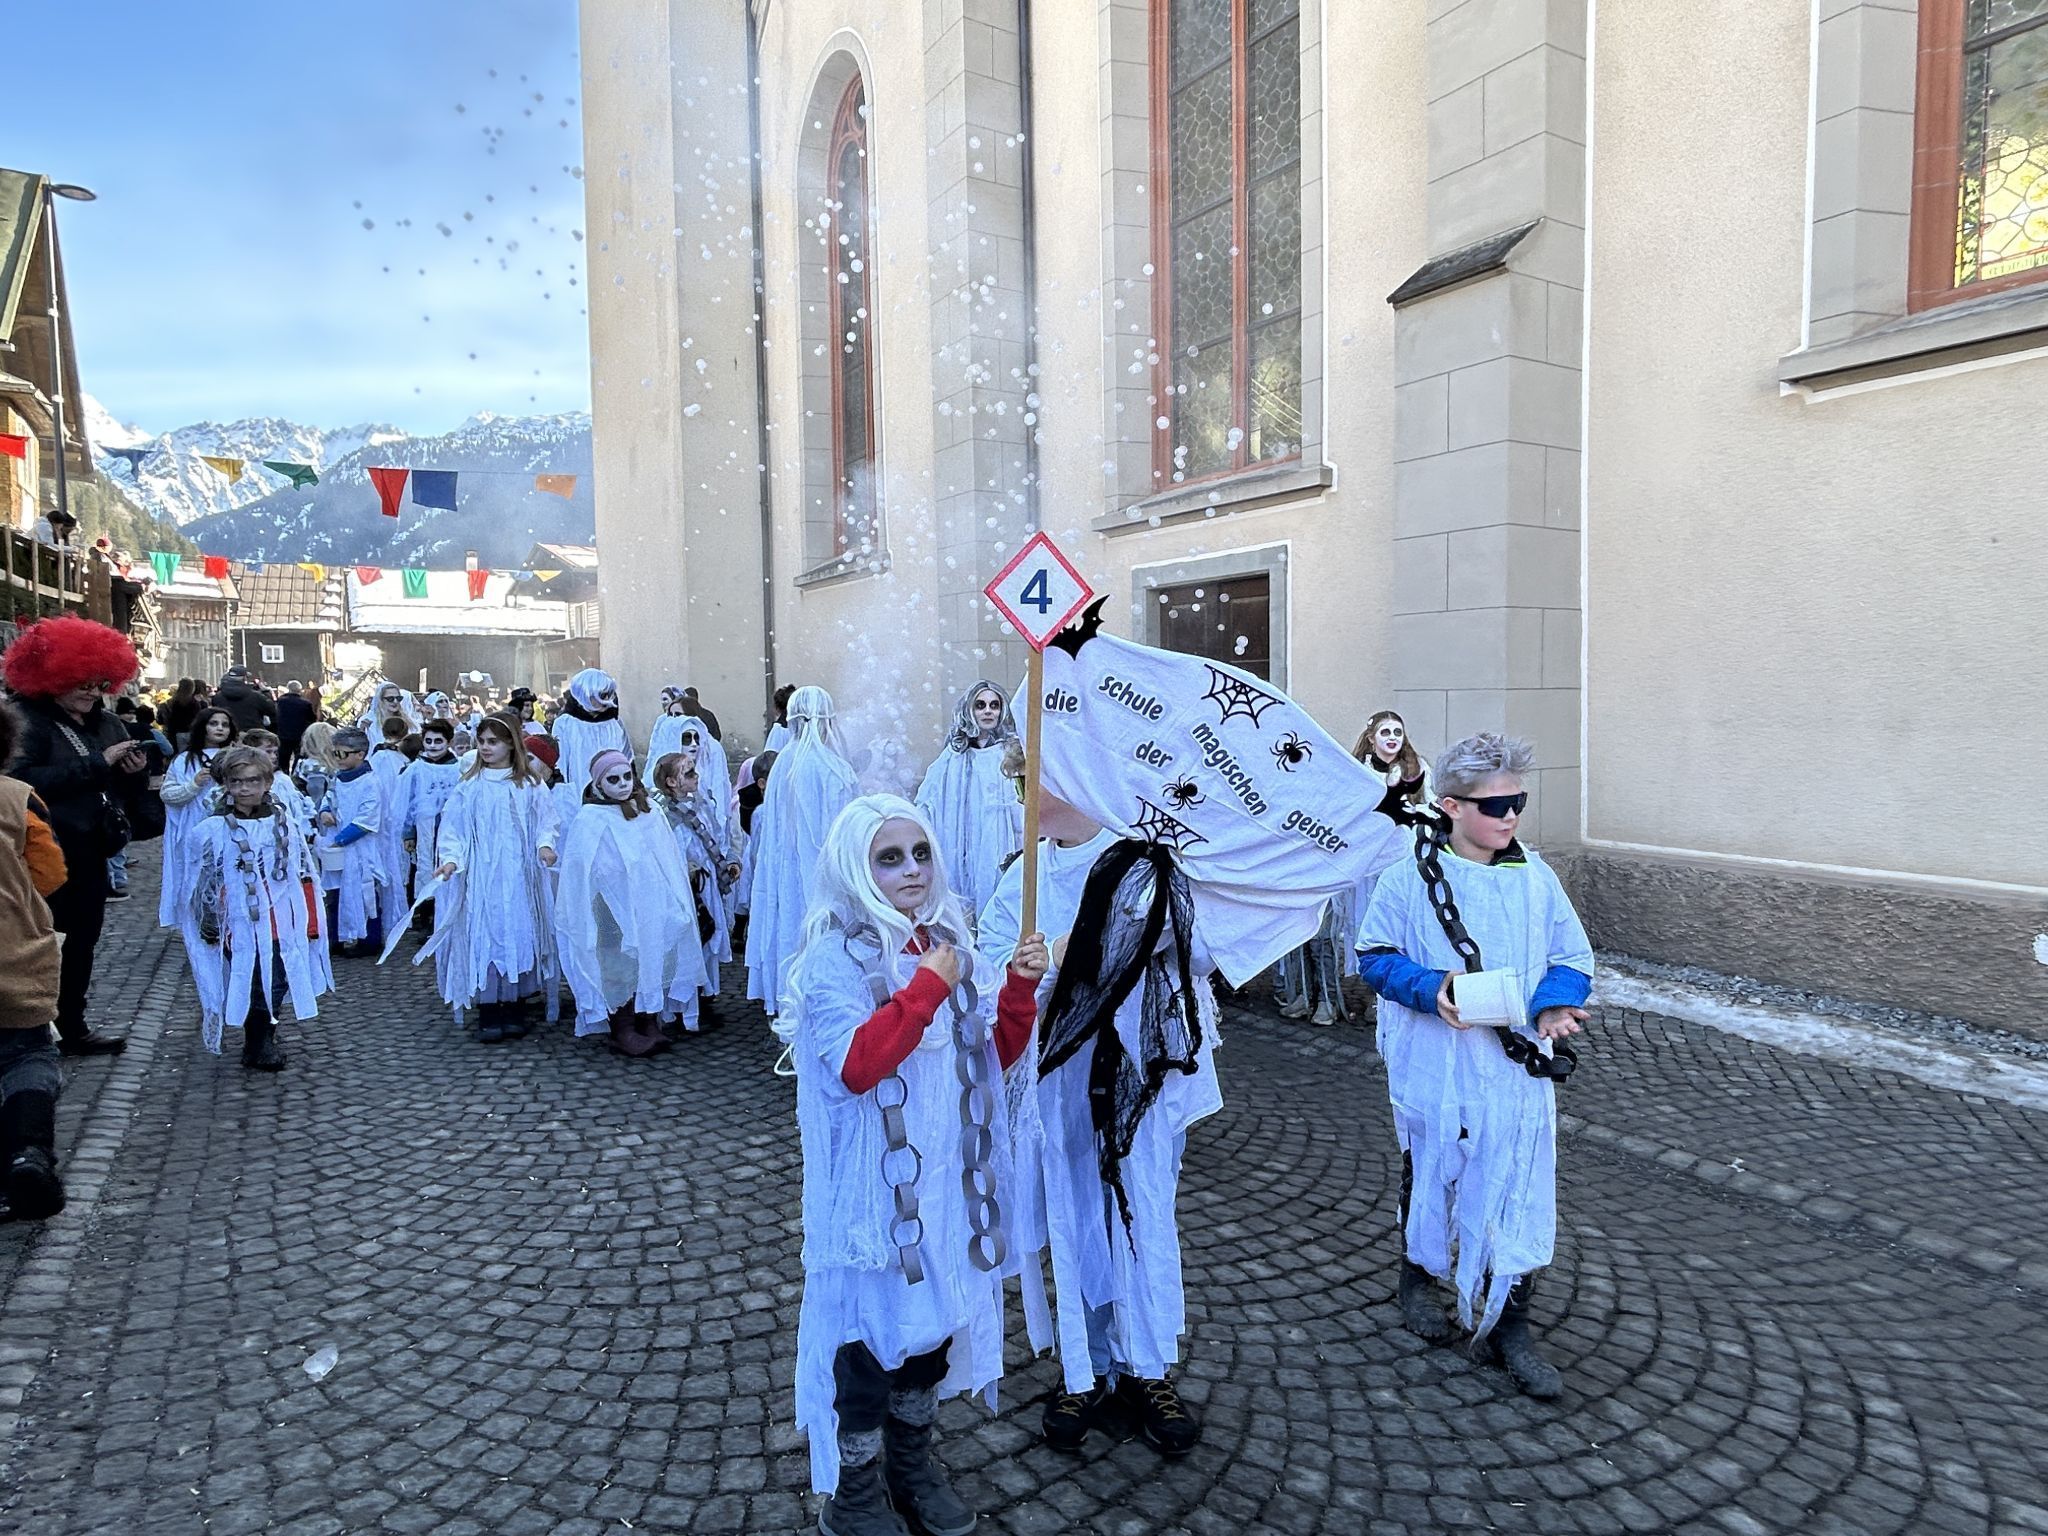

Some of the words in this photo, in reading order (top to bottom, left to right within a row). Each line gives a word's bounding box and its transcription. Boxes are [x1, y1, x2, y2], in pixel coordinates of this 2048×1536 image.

[1021, 569, 1053, 614] 4
[1045, 687, 1078, 713] die
[1098, 674, 1164, 721] schule
[1135, 740, 1174, 768] der
[1191, 721, 1268, 816] magischen
[1282, 809, 1350, 854] geister
